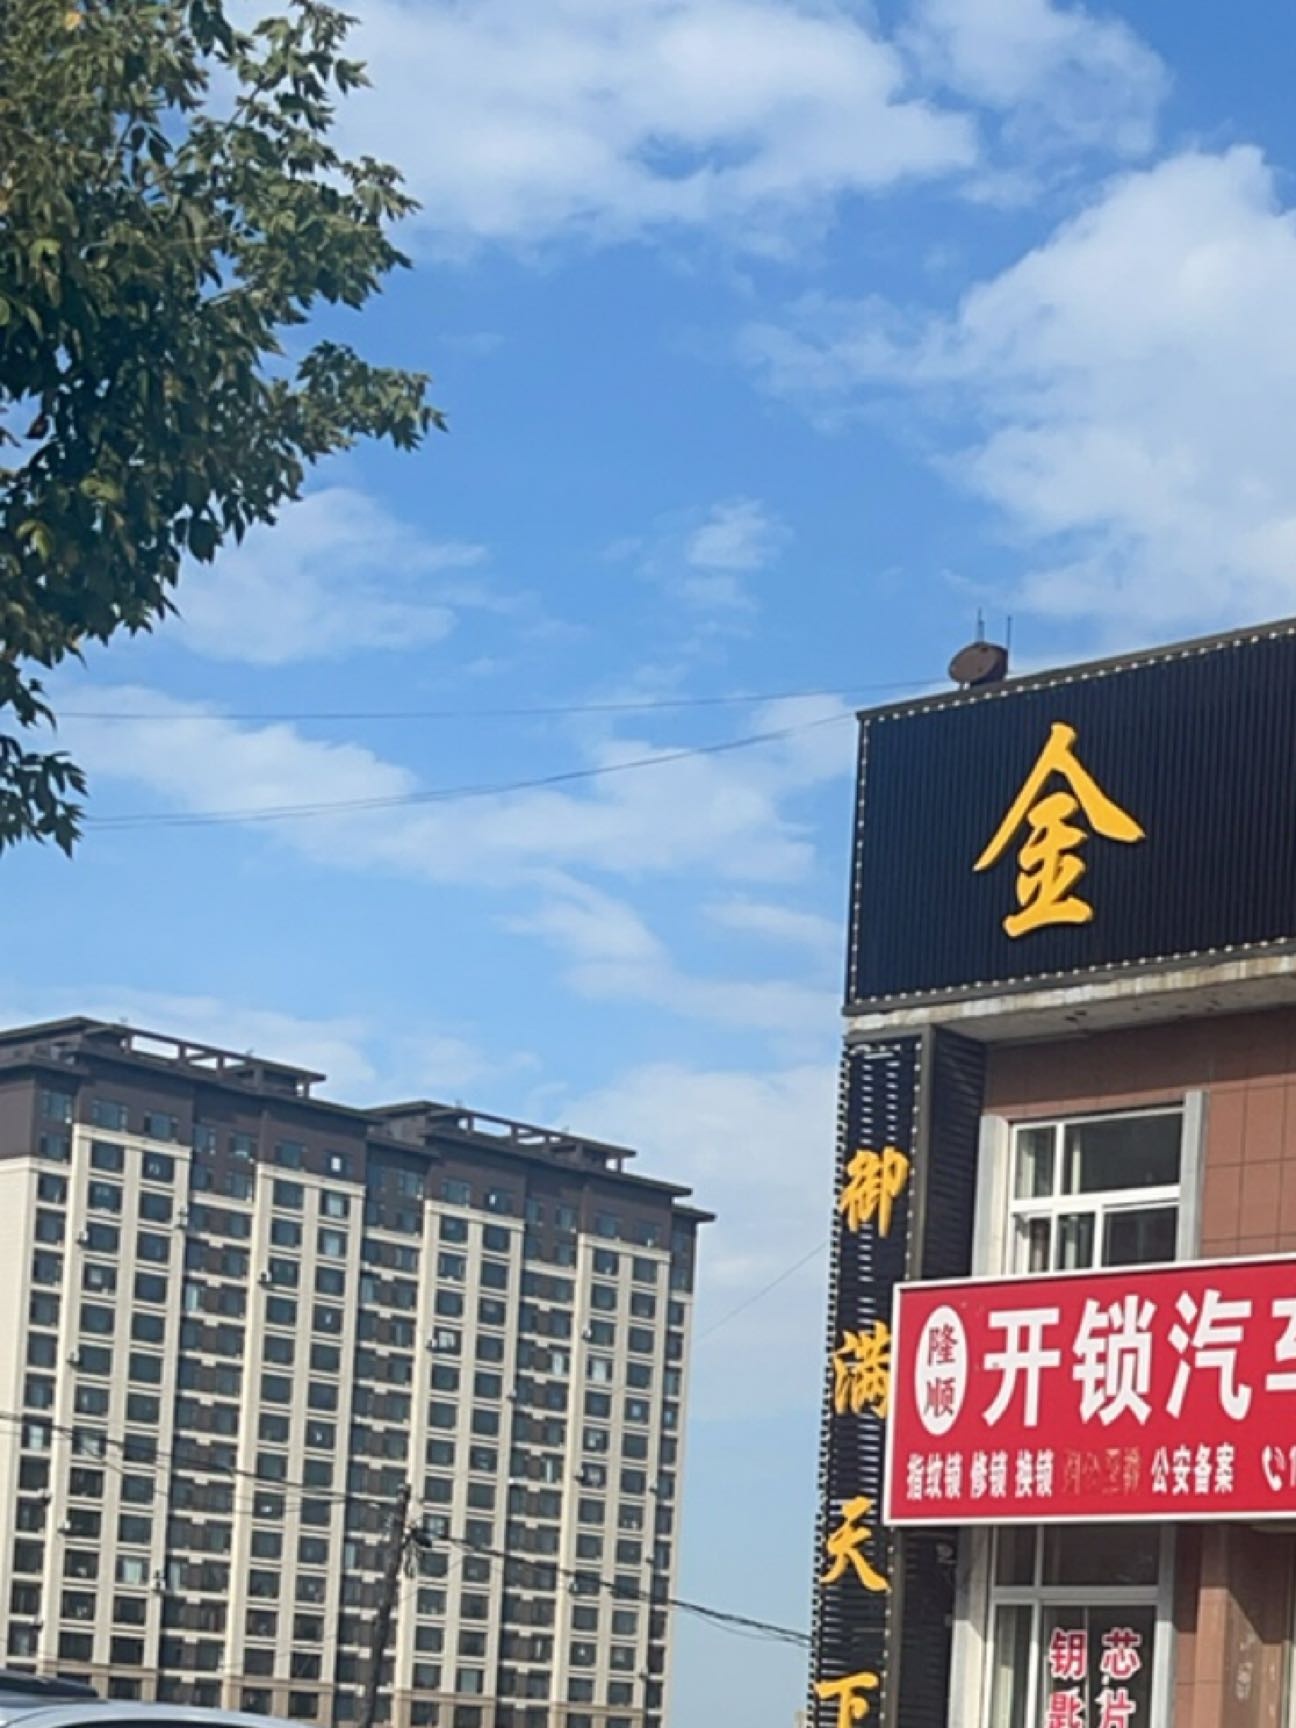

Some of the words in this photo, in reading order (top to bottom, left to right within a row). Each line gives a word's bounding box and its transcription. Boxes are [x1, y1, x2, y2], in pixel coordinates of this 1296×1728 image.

[925, 1324, 959, 1419] 隆顺
[1150, 1441, 1236, 1497] 公安备案
